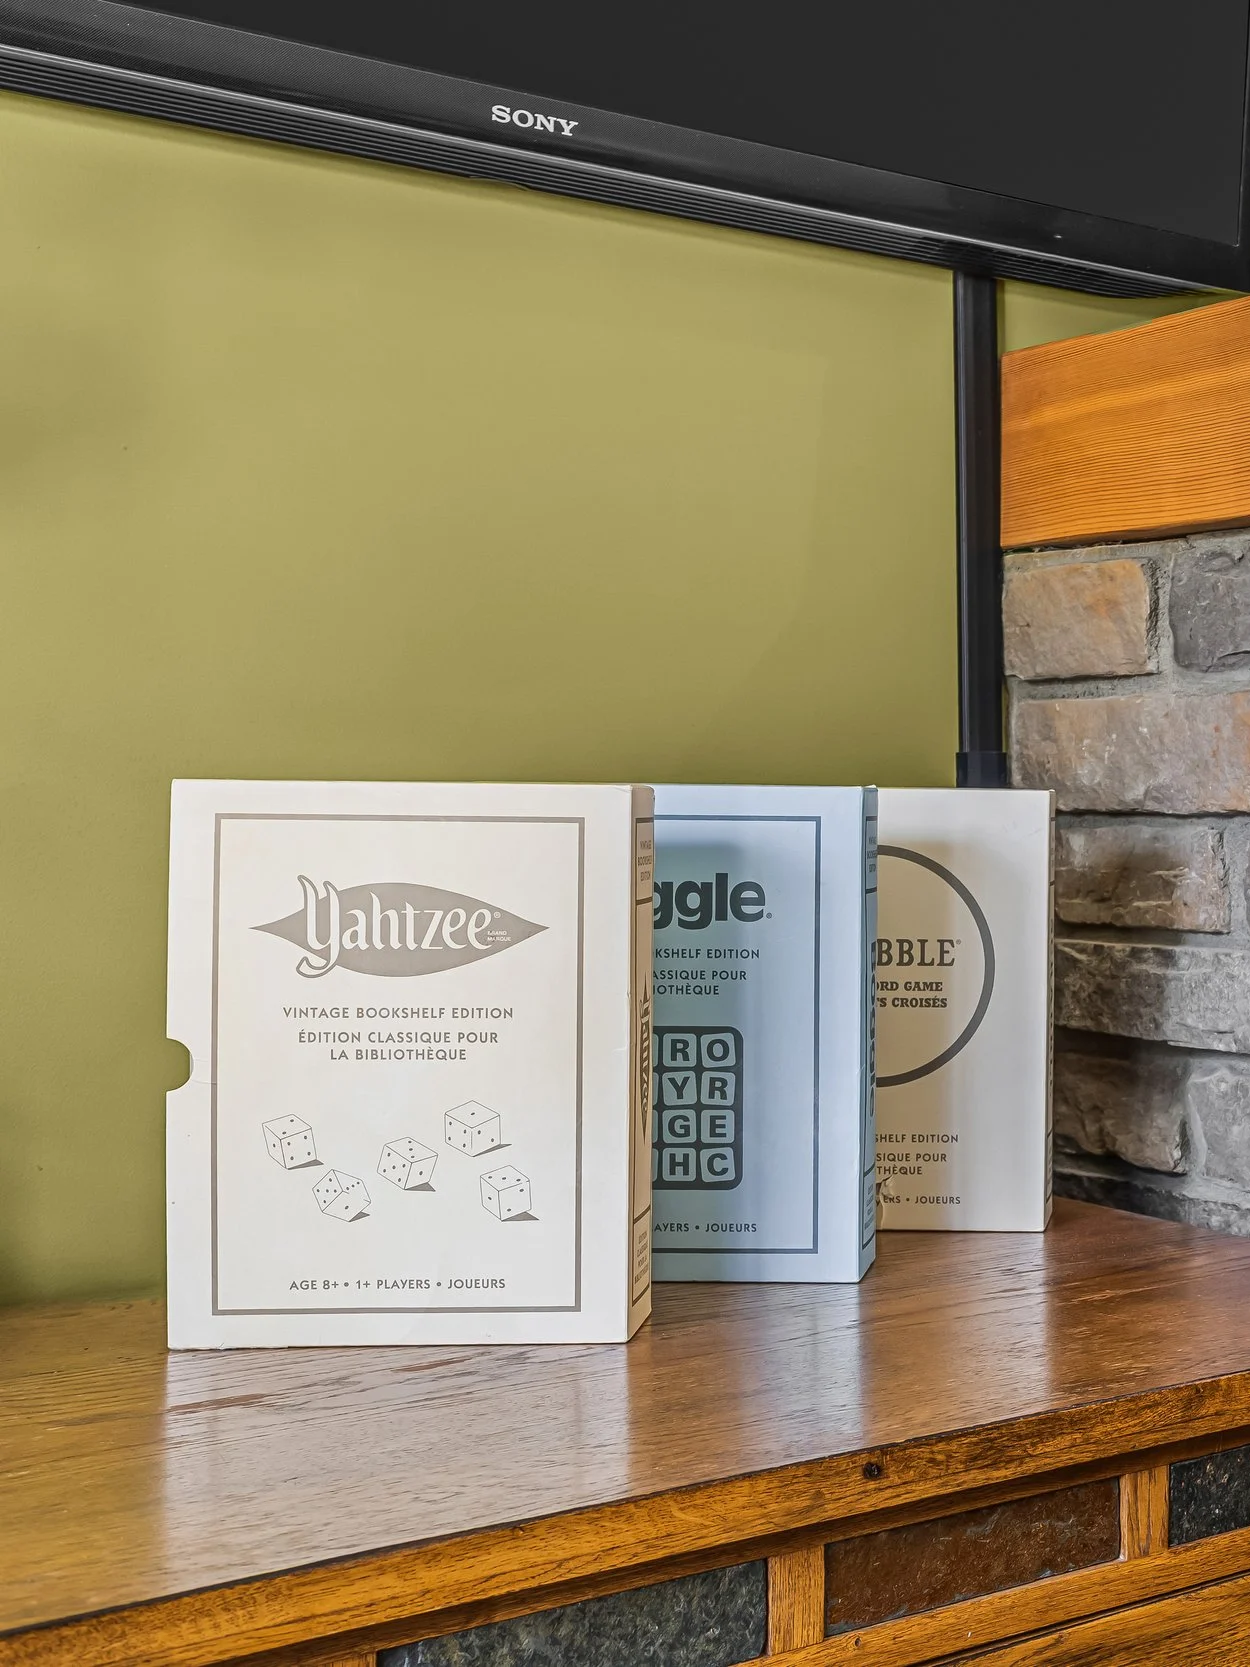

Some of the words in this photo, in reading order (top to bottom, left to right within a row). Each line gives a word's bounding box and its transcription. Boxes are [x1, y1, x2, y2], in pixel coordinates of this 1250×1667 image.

[491, 104, 579, 137] SONY
[296, 874, 493, 979] Yahtzee
[655, 948, 702, 959] KSHELF
[707, 948, 760, 960] EDITION
[711, 970, 747, 981] POUR
[903, 981, 943, 992] GAME
[891, 995, 948, 1009] CROISÉS
[283, 1007, 349, 1019] VINTAGE
[356, 1007, 446, 1019] BOOKSHELF
[452, 1007, 513, 1019] EDITION
[298, 1029, 361, 1044] ÉDITION
[368, 1032, 451, 1045] CLASSIQUE
[457, 1032, 498, 1044] POUR
[330, 1049, 349, 1061] LA
[355, 1046, 467, 1062] BIBLIOTHÈQUE
[670, 1039, 690, 1062] R
[706, 1038, 730, 1062] O
[667, 1076, 691, 1100] Y
[708, 1076, 728, 1101] R
[667, 1115, 691, 1138] G
[709, 1115, 727, 1138] E
[911, 1134, 959, 1144] EDITION
[669, 1153, 690, 1176] H
[706, 1153, 729, 1176] C
[915, 1153, 947, 1163] POUR
[914, 1195, 961, 1205] JOUEURS
[653, 1223, 690, 1233] AYERS
[705, 1223, 757, 1233] JOUEURS
[289, 1280, 318, 1291] AGE
[323, 1280, 339, 1290] 8+
[356, 1280, 371, 1290] 1+
[377, 1279, 431, 1290] PLAYERS
[447, 1279, 506, 1290] JOUEURS
